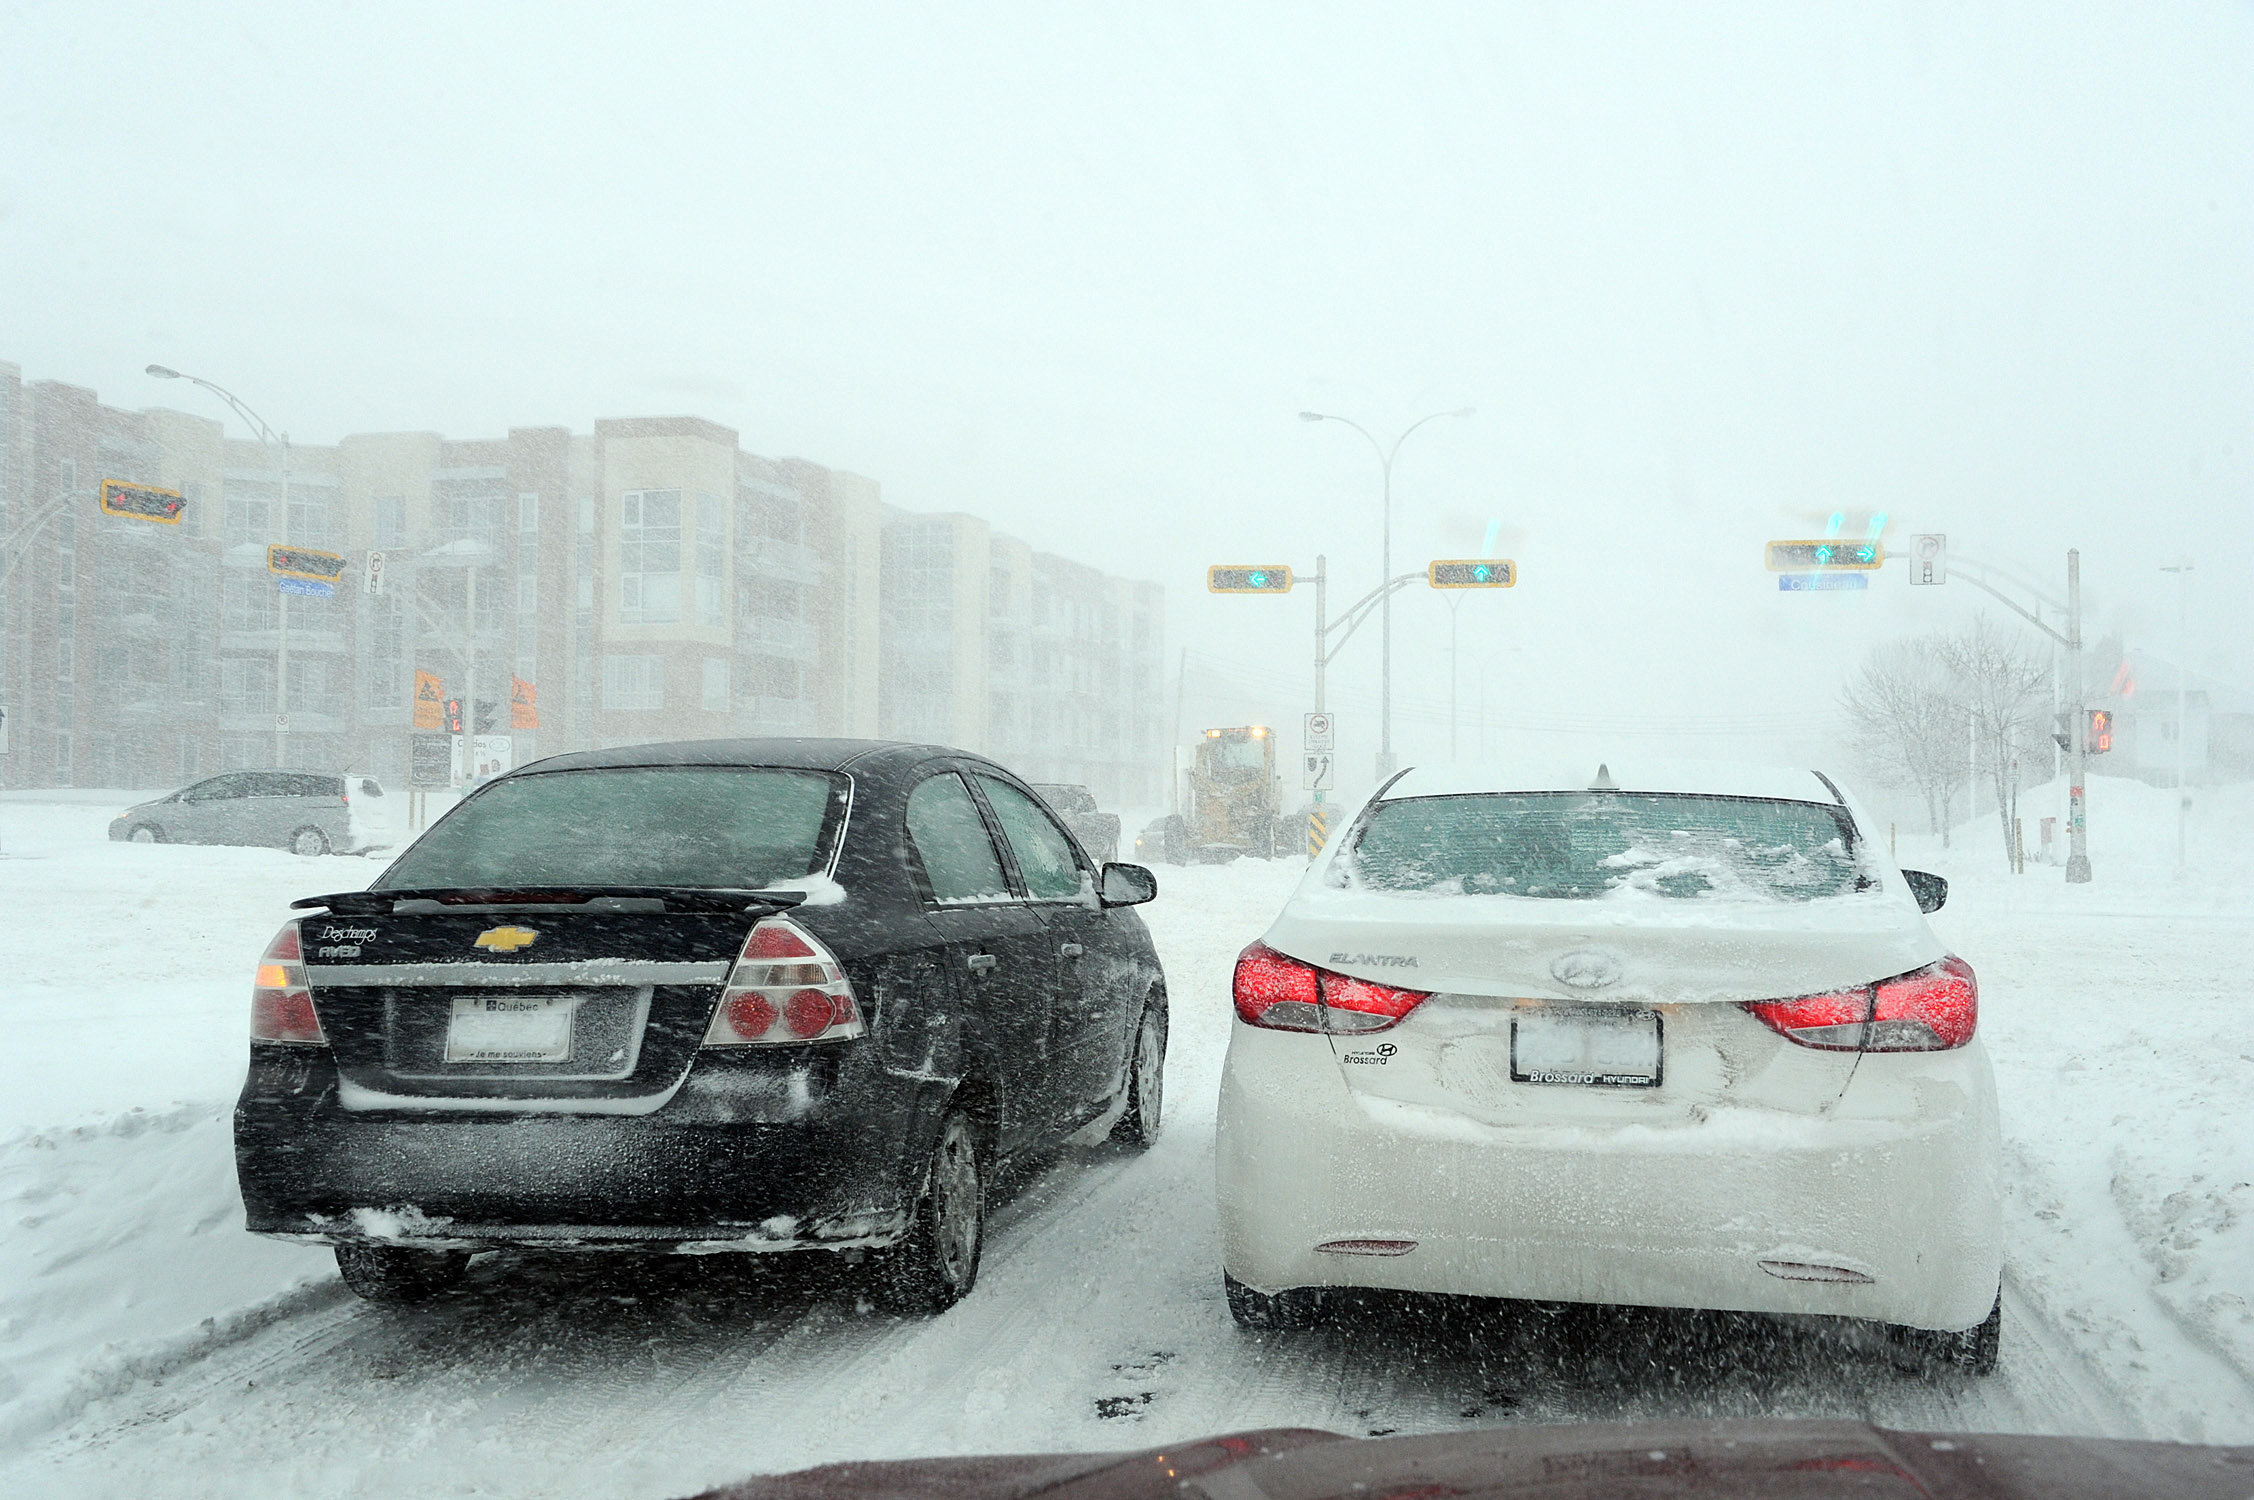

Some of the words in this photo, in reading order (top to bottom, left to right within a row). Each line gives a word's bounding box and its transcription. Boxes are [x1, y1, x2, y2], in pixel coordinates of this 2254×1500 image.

[321, 925, 378, 945] Deschamps
[1329, 953, 1418, 967] ELANTRA
[497, 1001, 539, 1012] Québec
[1343, 1054, 1388, 1065] Brossard
[1530, 1069, 1595, 1084] Brossard
[1602, 1075, 1650, 1084] HYUNDAI
